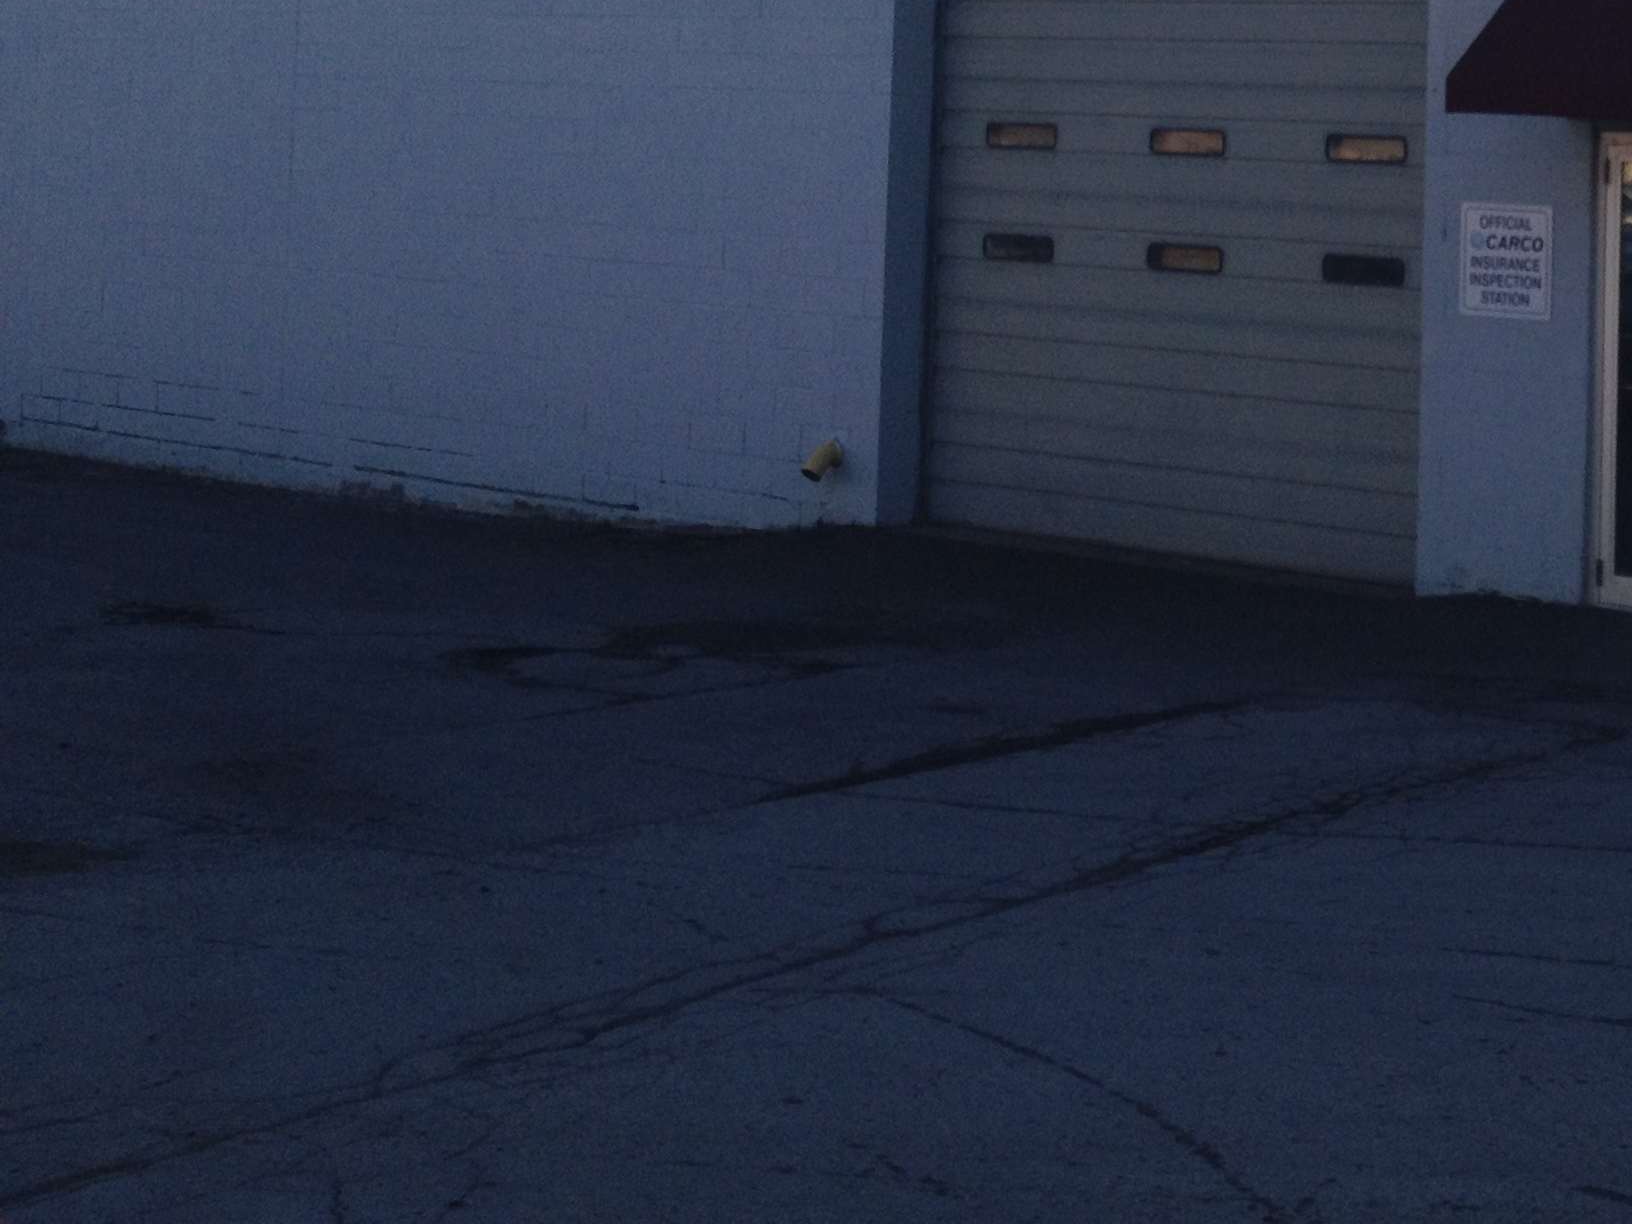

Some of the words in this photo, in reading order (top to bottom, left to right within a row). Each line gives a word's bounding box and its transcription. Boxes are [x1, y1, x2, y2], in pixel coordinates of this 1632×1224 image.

[1480, 216, 1532, 231] OFFICIAL
[1486, 235, 1544, 252] CARCO
[1470, 256, 1539, 272] INSURANCE
[1469, 273, 1541, 289] INSPECTION
[1480, 291, 1531, 306] STATION
